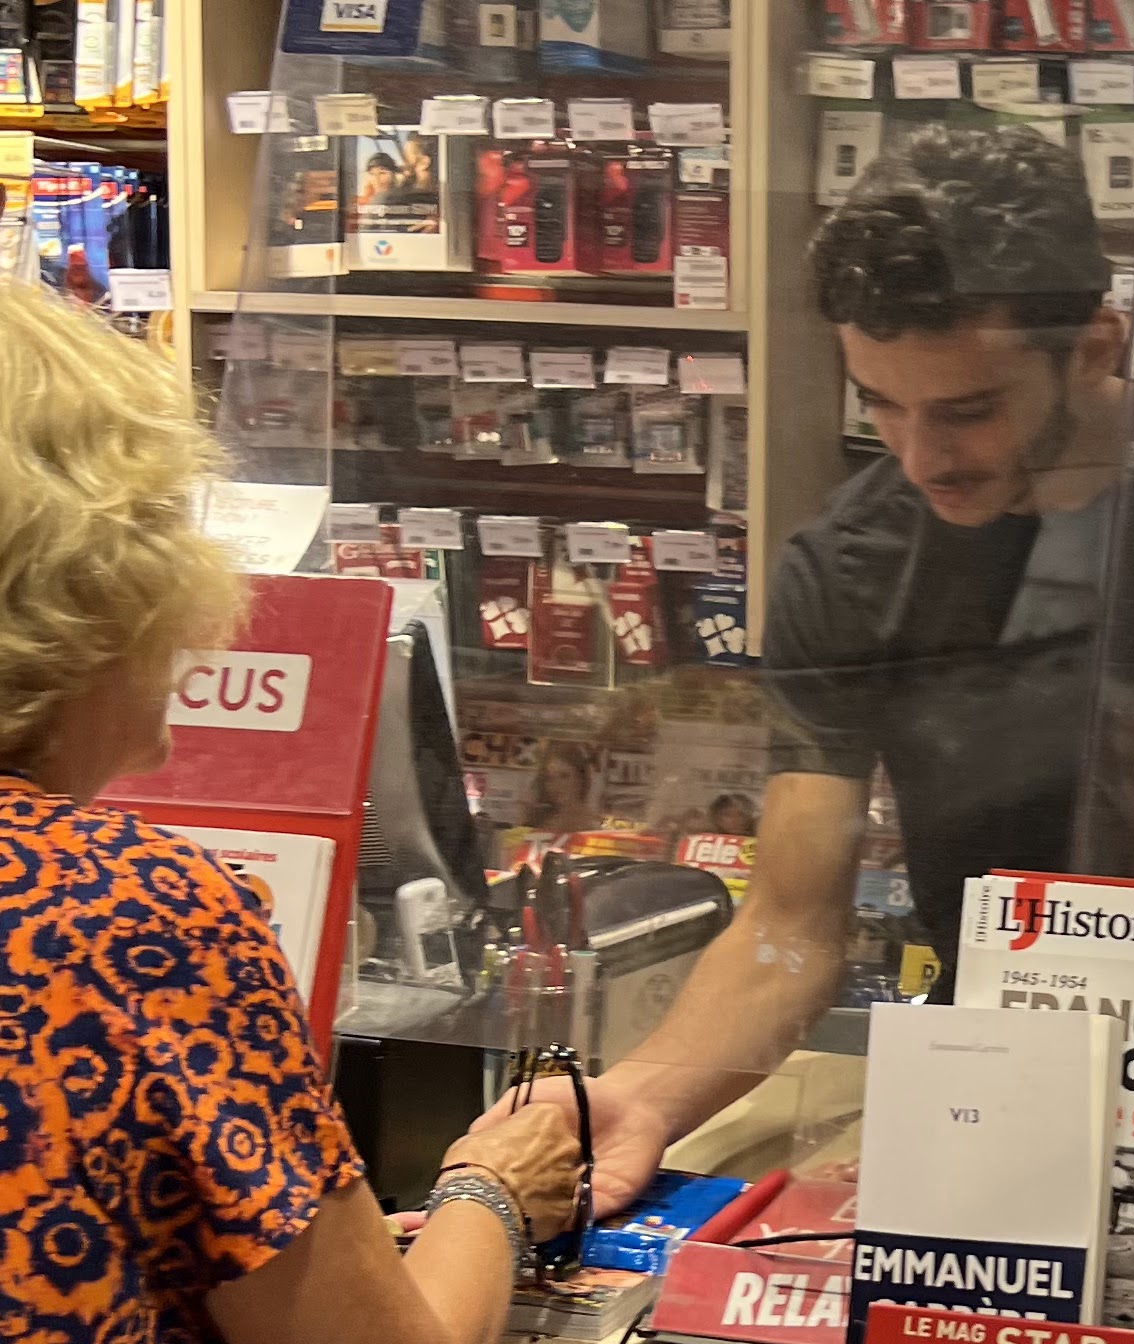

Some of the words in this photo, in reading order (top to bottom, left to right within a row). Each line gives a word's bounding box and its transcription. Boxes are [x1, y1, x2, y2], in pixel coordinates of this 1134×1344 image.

[332, 2, 377, 21] VISA
[1001, 969, 1088, 991] 1945-1954
[854, 1244, 1075, 1302] EMMANUEL
[721, 1271, 852, 1329] RELA
[903, 1315, 932, 1339] LE
[936, 1318, 987, 1344] MAG
